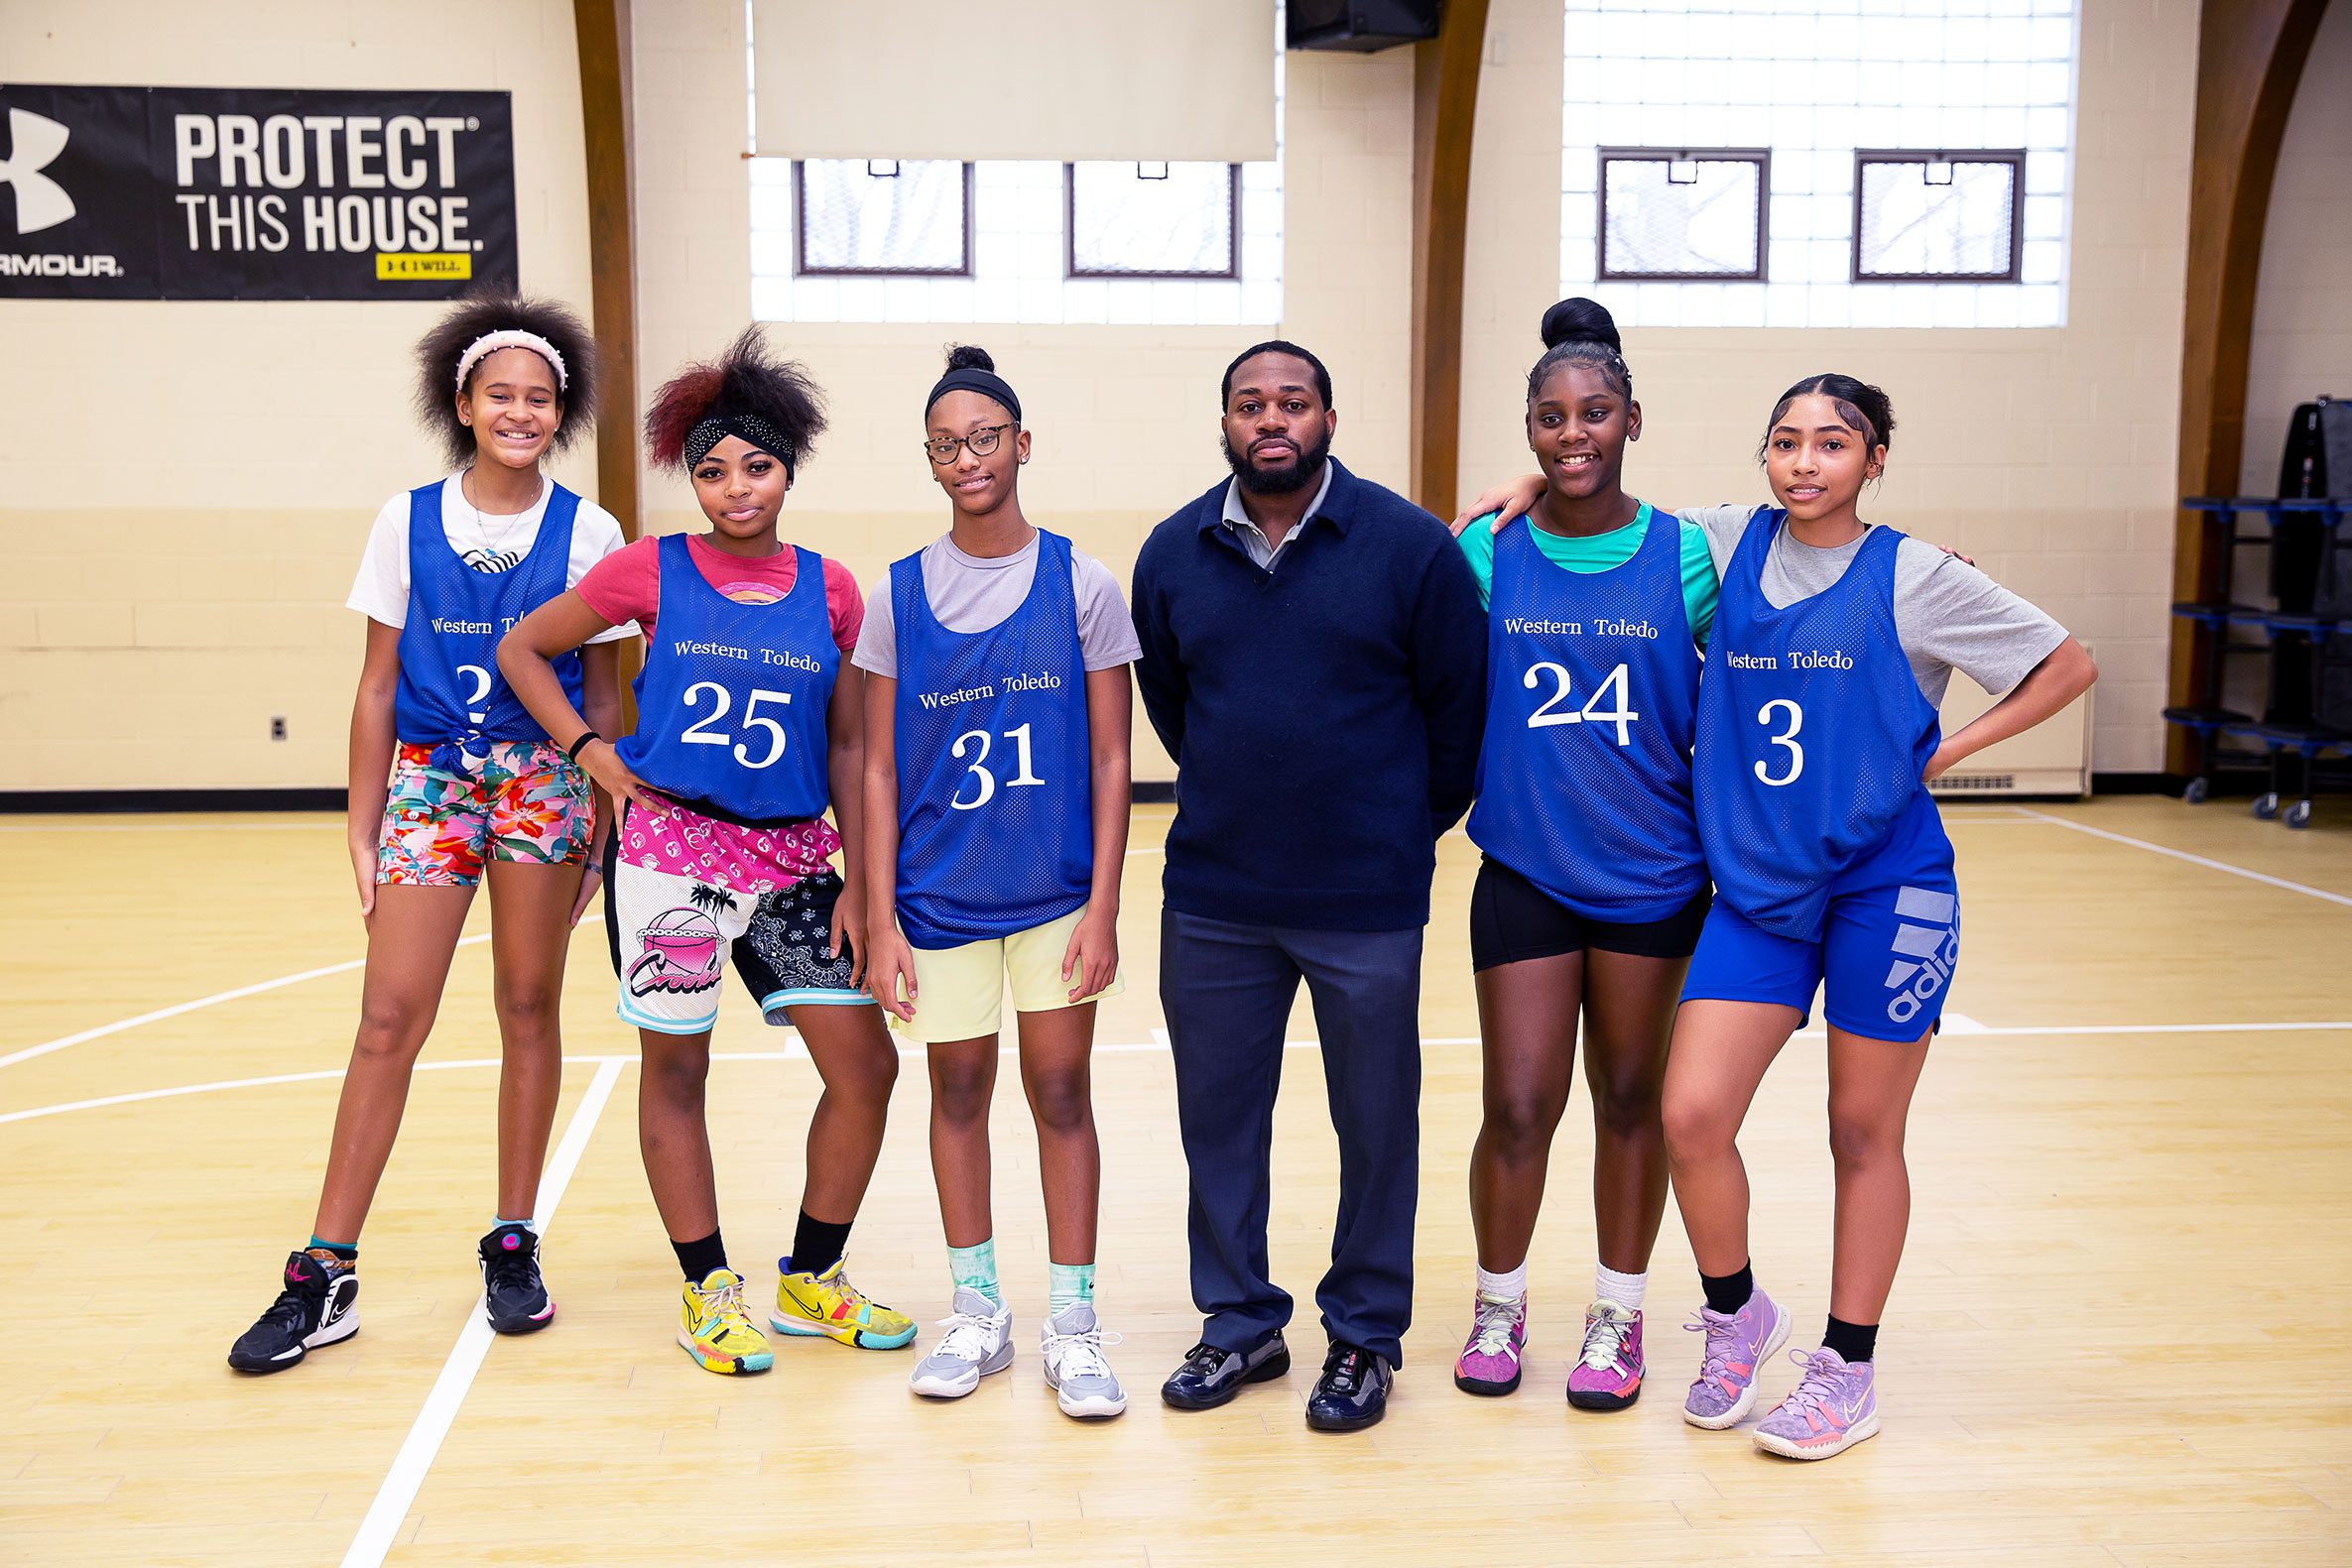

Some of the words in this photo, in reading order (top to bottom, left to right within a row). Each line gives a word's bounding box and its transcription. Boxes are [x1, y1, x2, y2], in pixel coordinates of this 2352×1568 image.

[175, 193, 291, 253] THIS
[302, 195, 484, 253] HOUSE.
[431, 617, 493, 635] Western
[1504, 618, 1582, 636] Western
[1594, 619, 1659, 641] Toledo
[675, 641, 748, 661] Western
[761, 649, 821, 673] Toledo
[1788, 651, 1854, 670] Toledo
[919, 684, 994, 710] Western
[1002, 670, 1060, 694] Toledo
[1523, 662, 1639, 747] 24
[681, 681, 792, 770] 25
[1754, 699, 1804, 786] 3
[950, 722, 1046, 811] 31
[1887, 891, 1961, 1024] adid
